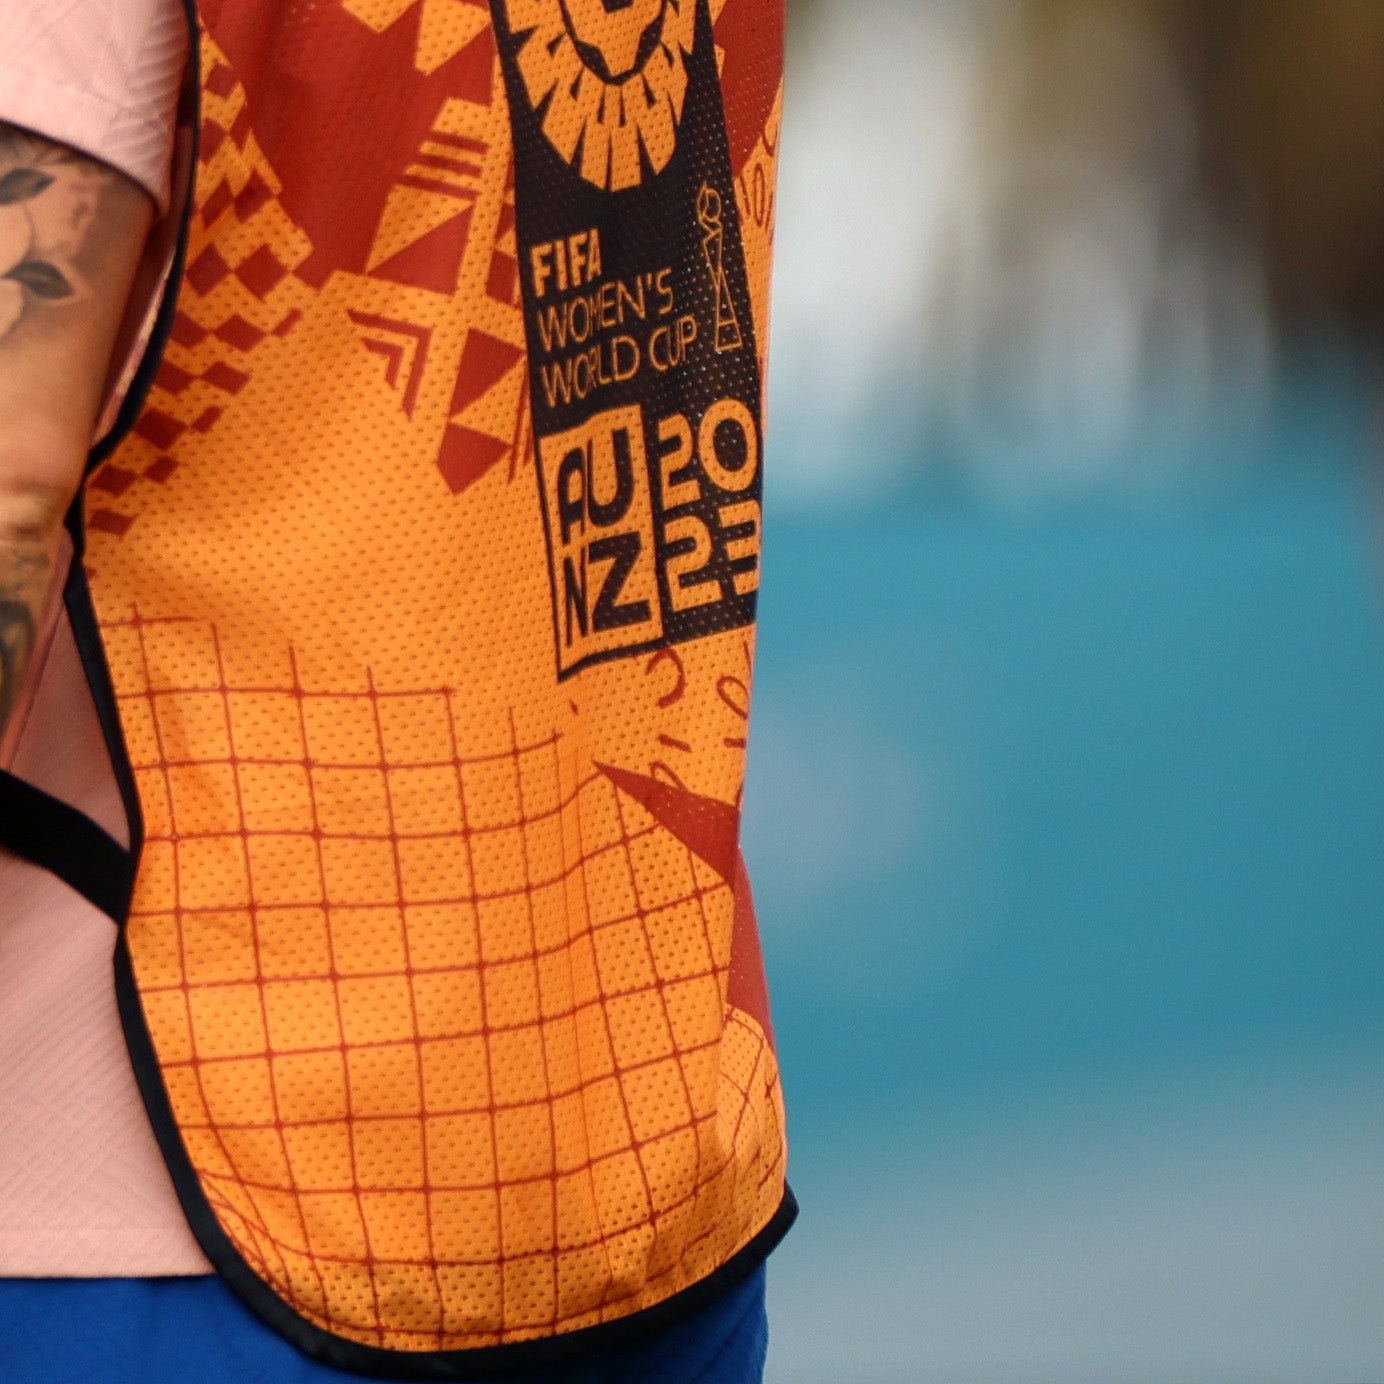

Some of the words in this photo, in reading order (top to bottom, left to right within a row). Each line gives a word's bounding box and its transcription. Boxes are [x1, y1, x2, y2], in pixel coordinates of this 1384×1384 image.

[531, 228, 602, 297] FIFA
[538, 268, 674, 352] WOMEN'S
[542, 335, 641, 407] WORLD
[649, 314, 698, 371] CUP
[658, 398, 758, 511] 20
